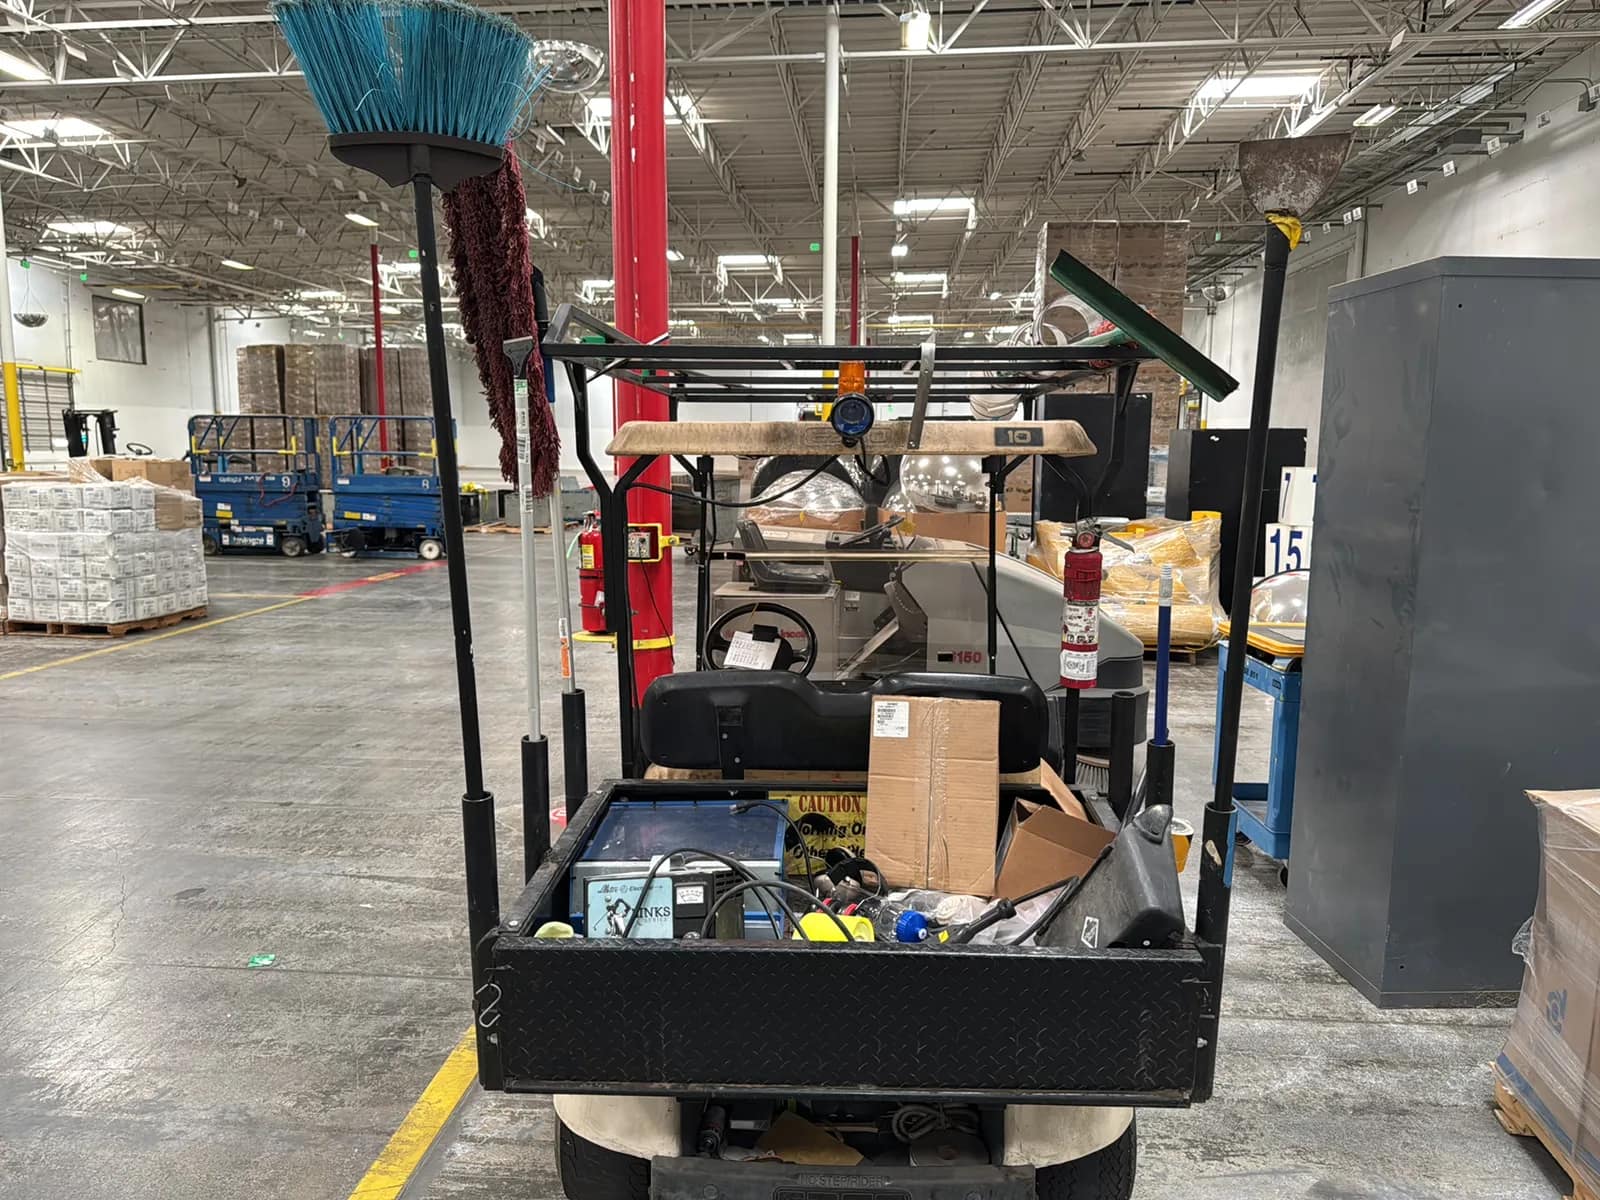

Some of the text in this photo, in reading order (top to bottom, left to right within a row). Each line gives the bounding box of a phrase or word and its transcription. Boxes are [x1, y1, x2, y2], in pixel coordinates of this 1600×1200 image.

[281, 476, 291, 488] 9
[1269, 527, 1303, 575] 15
[798, 794, 862, 813] CAUTION
[633, 906, 672, 918] INKS
